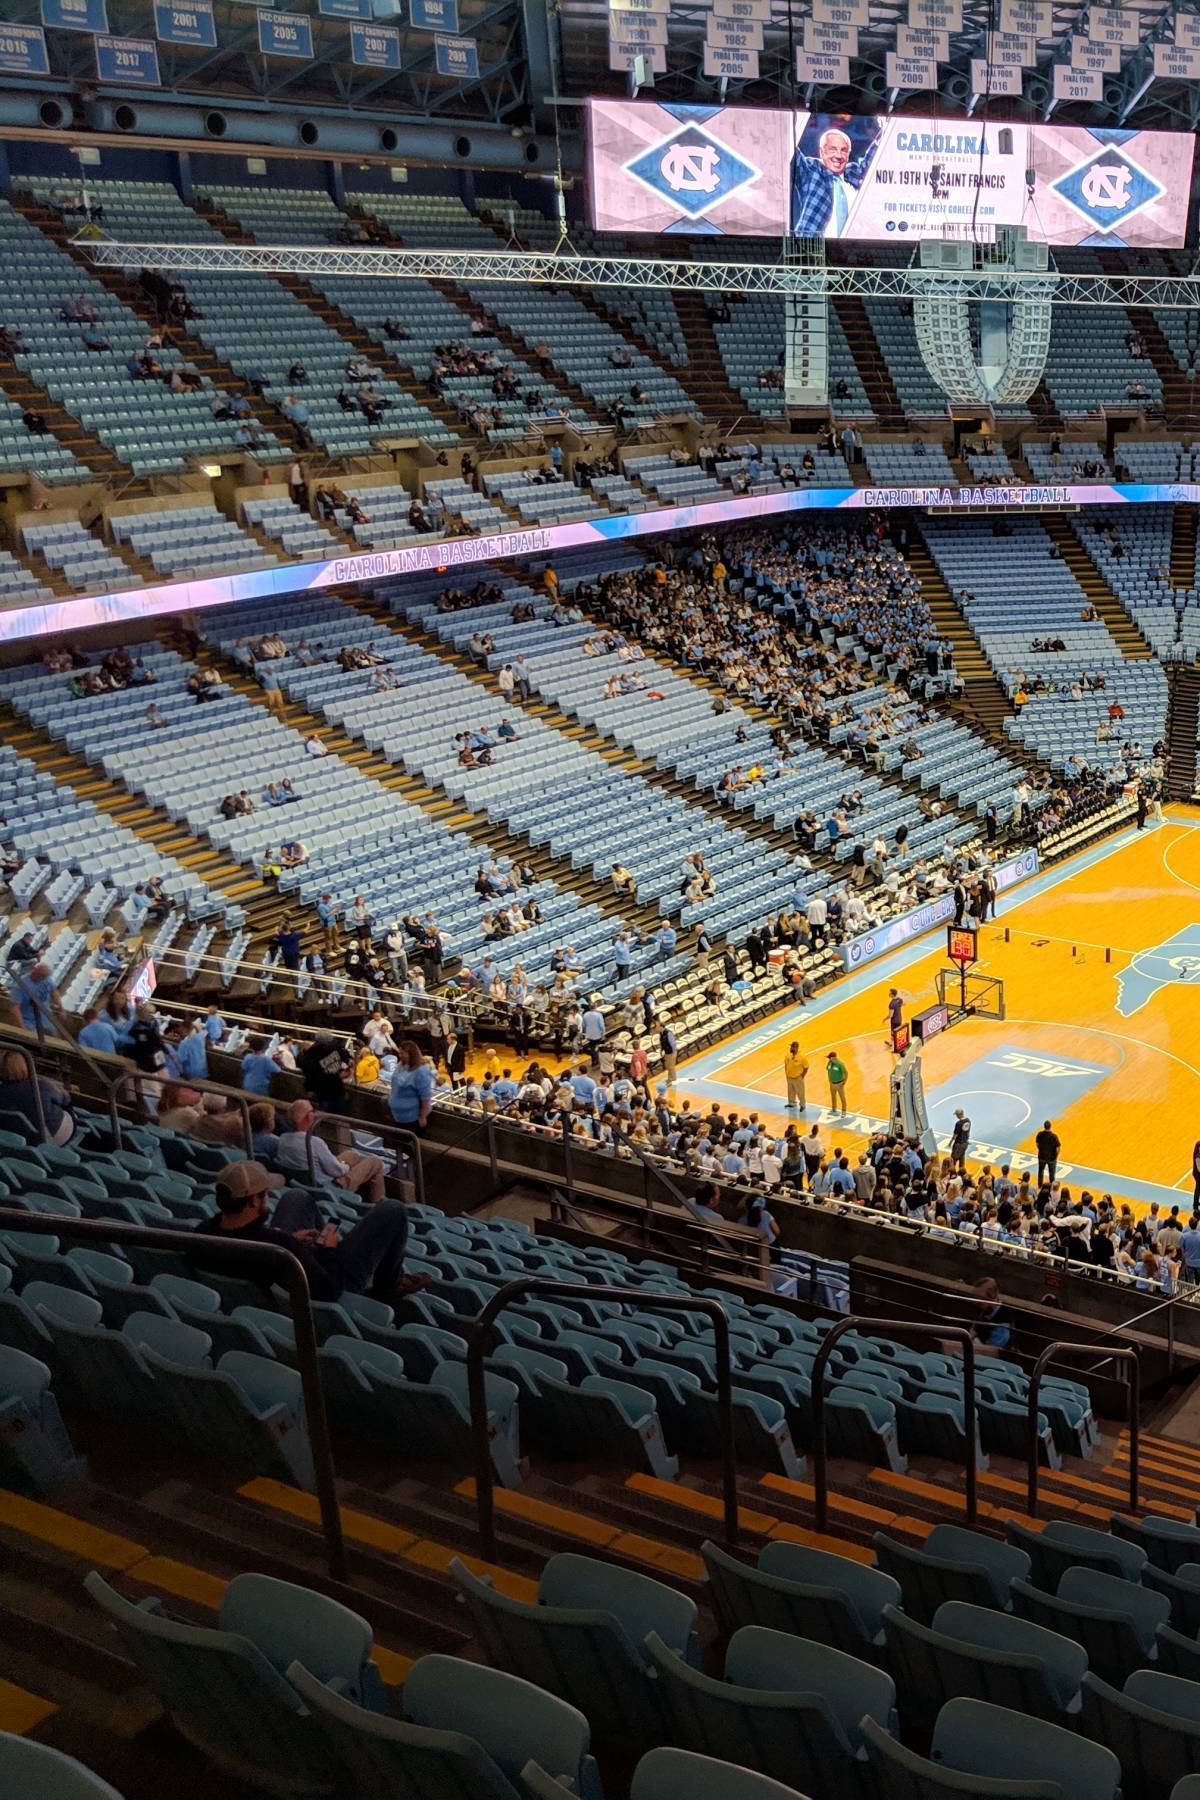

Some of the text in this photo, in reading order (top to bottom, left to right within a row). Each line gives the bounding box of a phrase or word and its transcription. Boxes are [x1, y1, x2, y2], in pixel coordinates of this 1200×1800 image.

[172, 12, 198, 28] 2001
[273, 26, 297, 40] 2005
[725, 34, 747, 46] 1982
[1105, 30, 1124, 41] 1972
[0, 39, 28, 54] 2016
[822, 41, 841, 52] 1991
[116, 52, 140, 66] 2017
[1002, 52, 1022, 63] 1995
[902, 73, 924, 84] 2009
[989, 81, 1008, 91] 016
[1069, 86, 1088, 97] 2017
[897, 132, 989, 155] CAROLINA
[875, 170, 1006, 189] NOV. 19TH SAINT FRANCIS
[884, 202, 995, 215] FOR TICKETS VISIT GOHEEL.COM
[864, 488, 1072, 505] CAROLINA BASKETBALL
[334, 530, 551, 581] CAROLINA BASKETBALL
[985, 1051, 1104, 1077] ACC
